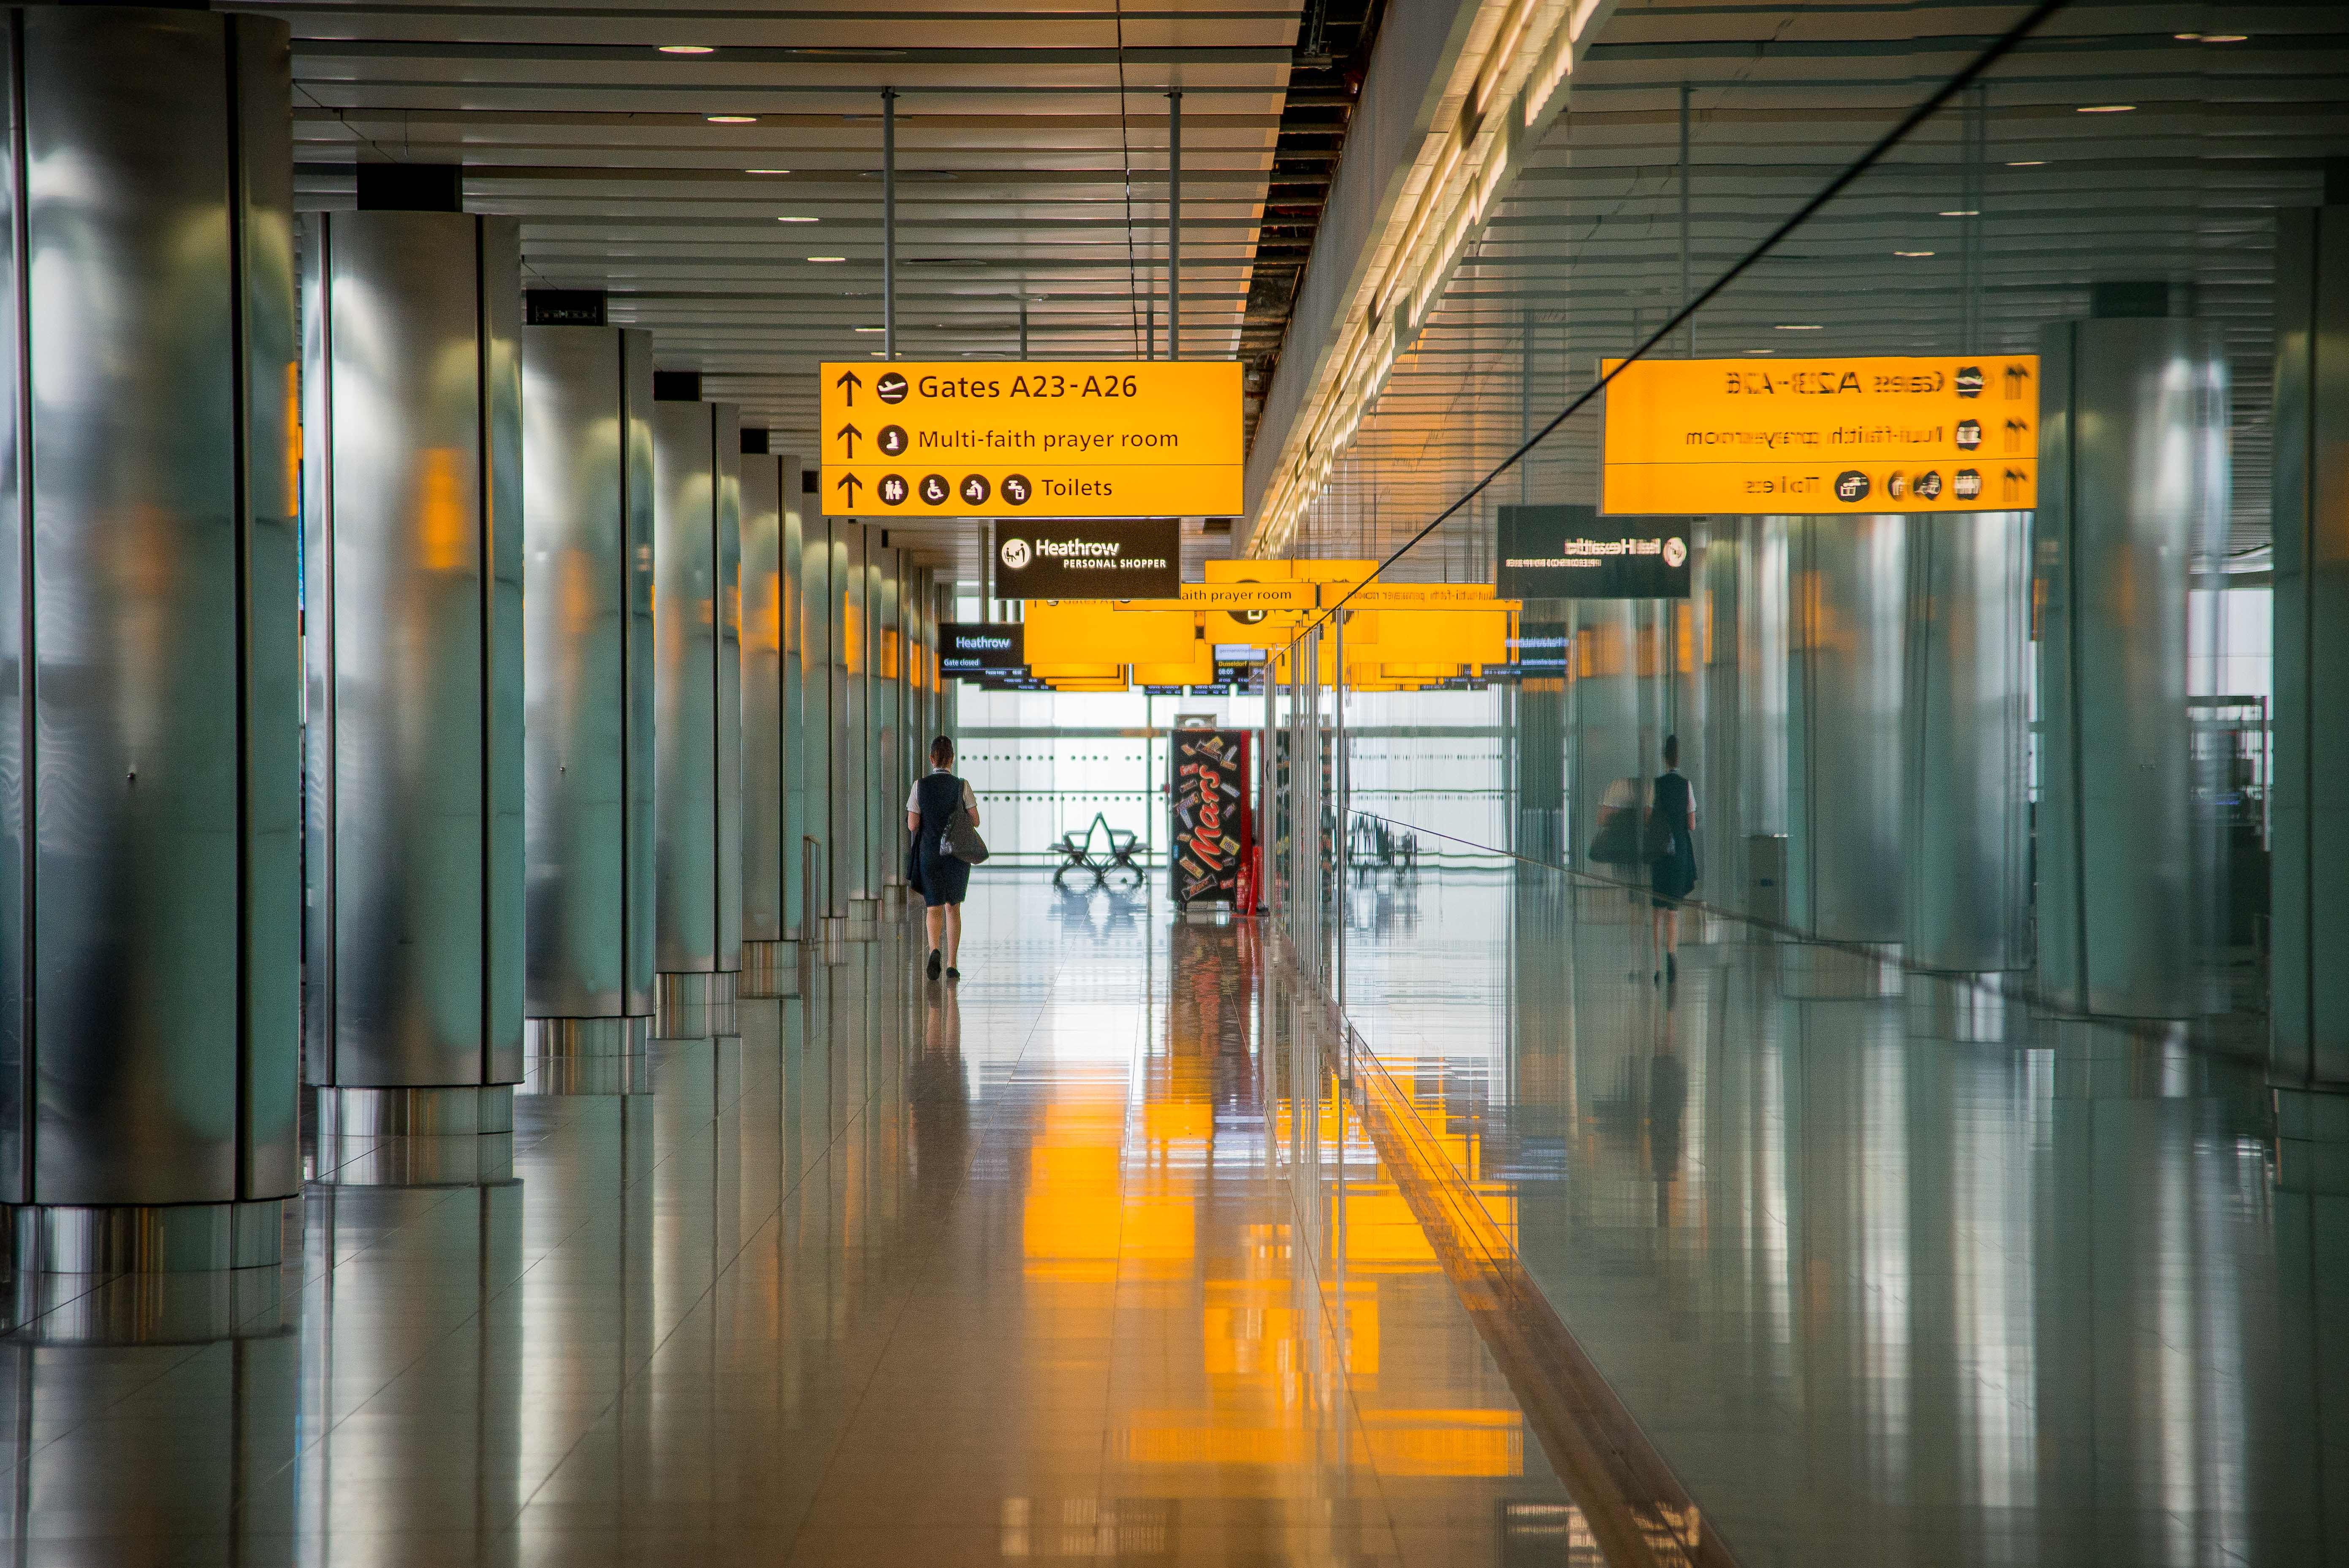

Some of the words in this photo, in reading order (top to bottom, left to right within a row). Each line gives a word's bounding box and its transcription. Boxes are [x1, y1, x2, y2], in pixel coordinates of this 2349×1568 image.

[919, 375, 1000, 398] Gates
[1010, 375, 1137, 398] A23-A26
[919, 429, 1035, 448] Multi-faith
[1044, 434, 1115, 452] prayer
[1122, 434, 1178, 447] room
[1041, 478, 1112, 496] Toilets
[1036, 538, 1120, 556] Heathrow
[1063, 559, 1117, 569] PERSONAL
[1120, 559, 1166, 568] SHOPPER
[1182, 589, 1206, 600] aith
[1211, 591, 1253, 602] prayer
[1257, 591, 1292, 600] room
[956, 636, 1011, 648] Heathrow
[1189, 764, 1223, 871] Mars
